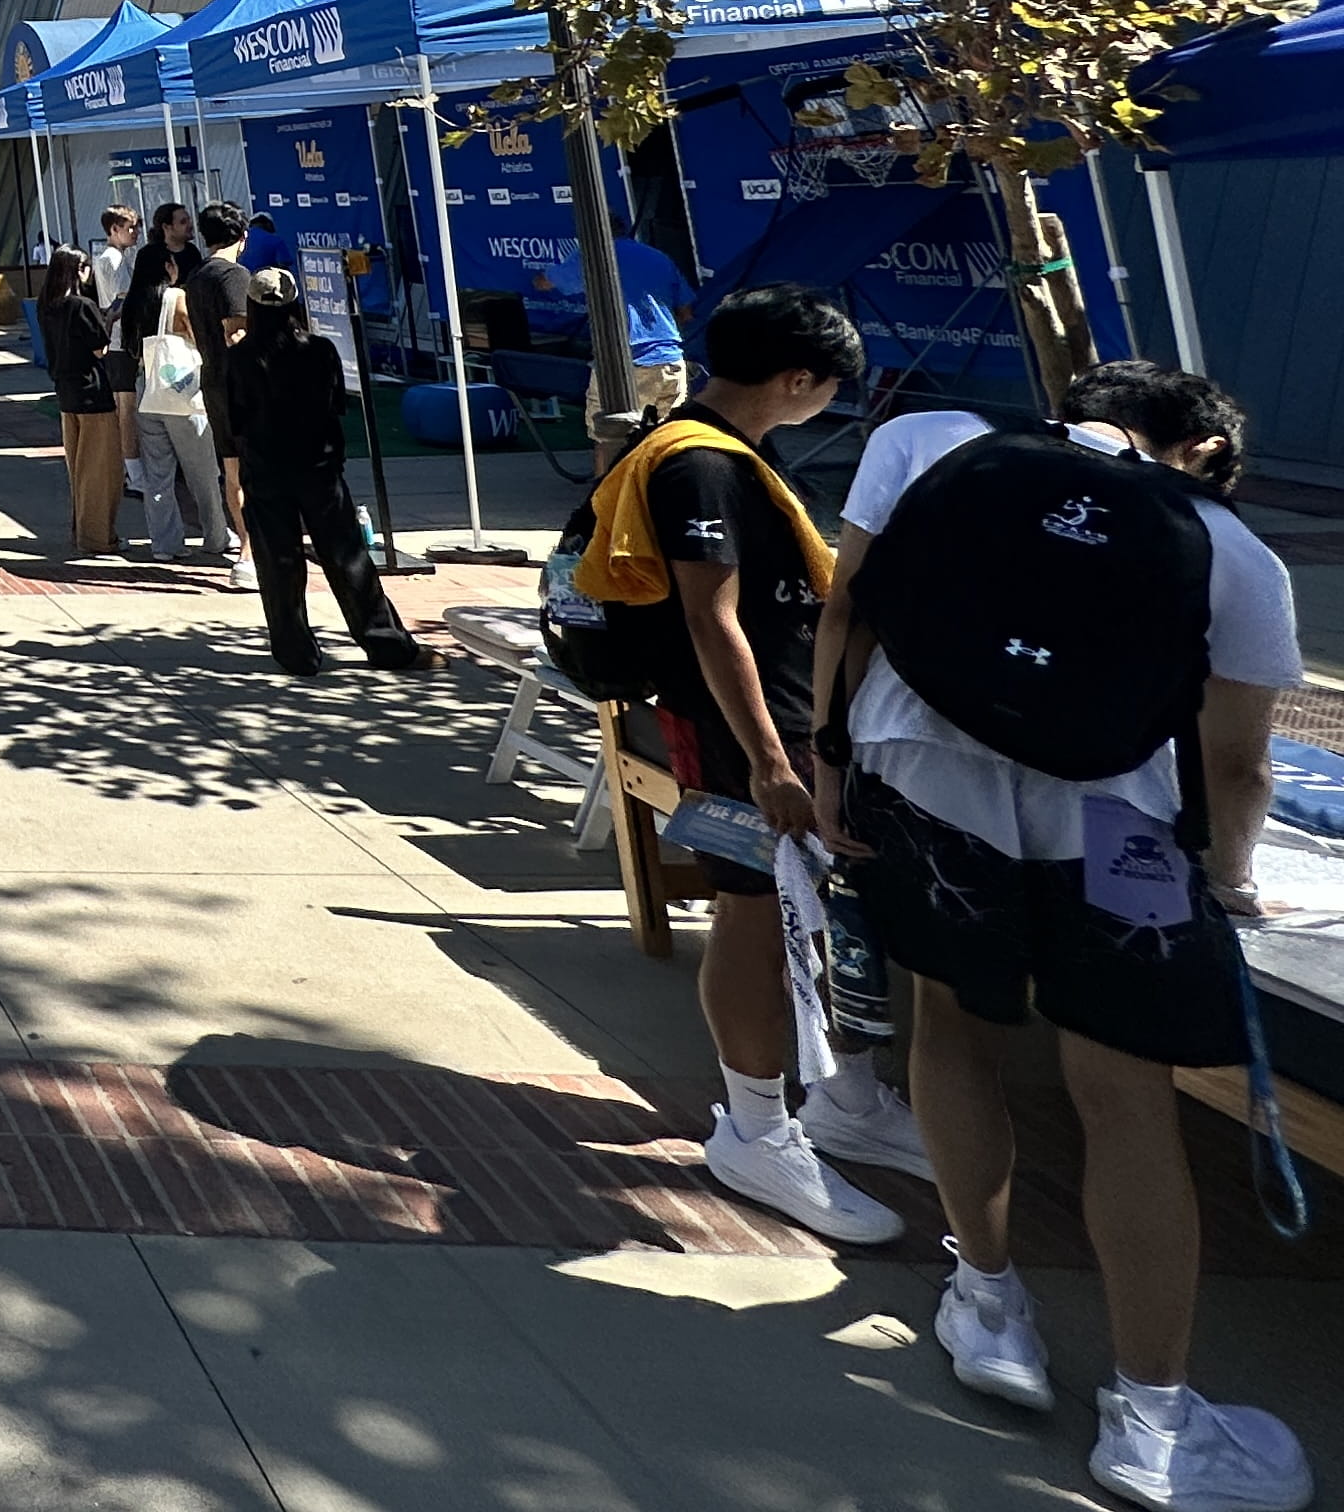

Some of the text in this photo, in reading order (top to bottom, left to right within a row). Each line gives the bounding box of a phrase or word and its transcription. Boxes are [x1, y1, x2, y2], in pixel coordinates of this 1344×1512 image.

[233, 17, 310, 64] WESCOM
[268, 51, 312, 74] Financial
[64, 70, 108, 101] WESCOM
[486, 120, 532, 156] Ucla
[747, 184, 777, 195] UCLA
[297, 231, 337, 249] WESCOM
[488, 237, 555, 259] WESCOM
[895, 270, 962, 287] Financial
